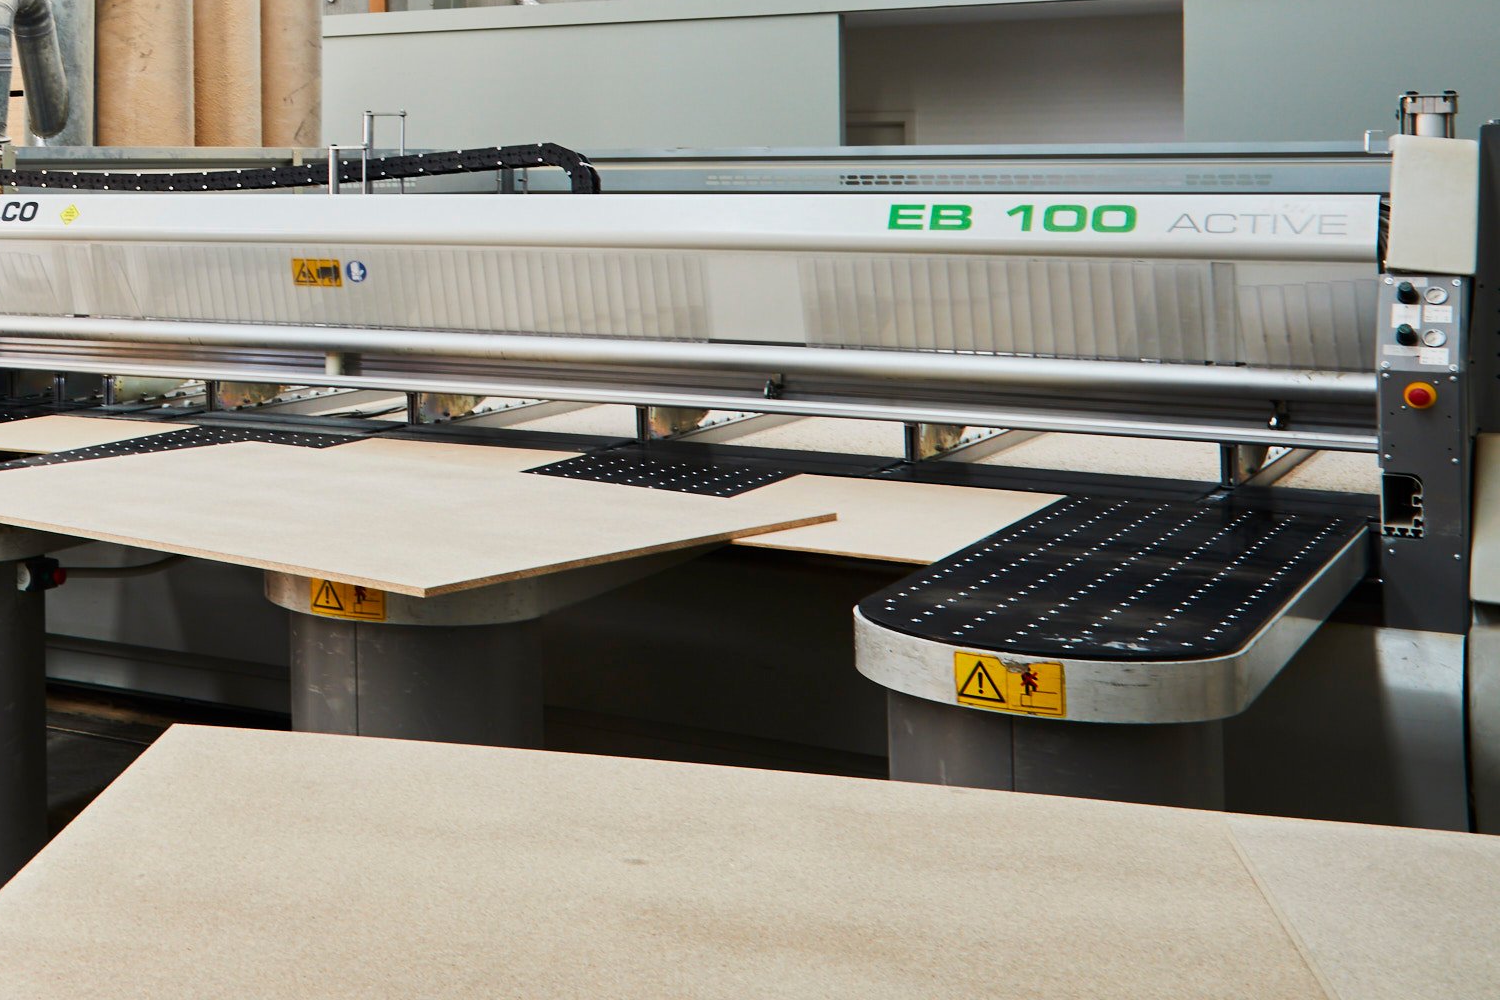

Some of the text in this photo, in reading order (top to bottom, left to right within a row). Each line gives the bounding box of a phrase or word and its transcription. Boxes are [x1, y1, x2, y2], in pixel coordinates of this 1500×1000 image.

[887, 204, 1348, 235] EB 100 ACTIVE
